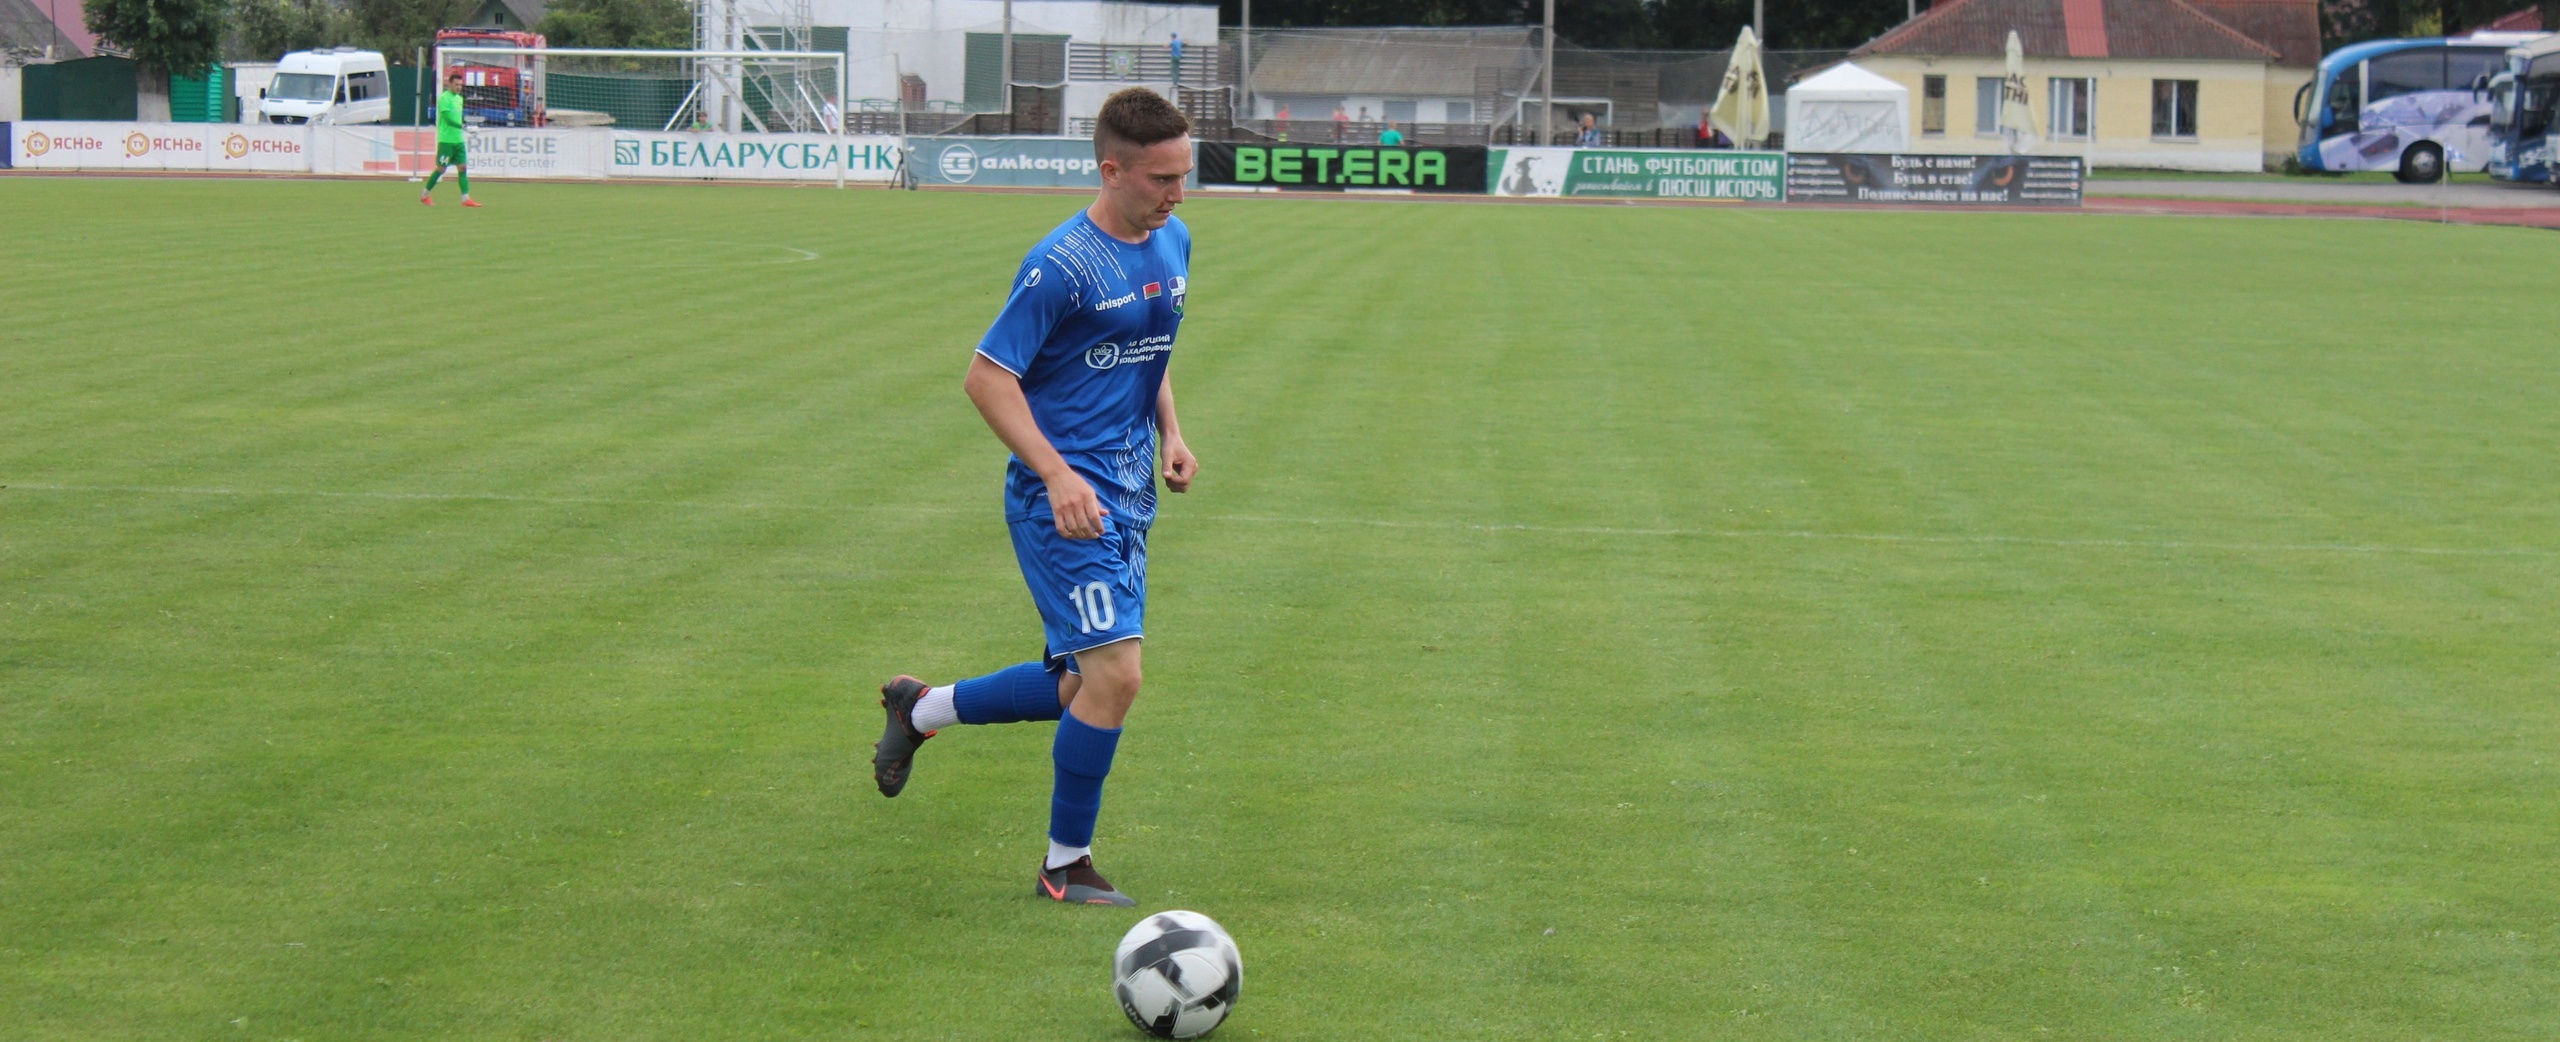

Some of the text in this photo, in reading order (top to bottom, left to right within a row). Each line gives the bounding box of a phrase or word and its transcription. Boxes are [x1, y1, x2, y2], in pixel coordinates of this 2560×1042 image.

[33, 140, 44, 148] TV
[133, 140, 144, 148] TV
[232, 141, 243, 149] TV
[468, 136, 557, 154] RILESIE
[468, 156, 556, 169] gistic Center
[651, 140, 895, 170] БЕЛАРУСБАНК
[1891, 155, 1976, 171] Будь с нами!
[1235, 147, 1447, 186] BET.ERA
[1582, 156, 1639, 174] СТАНЬ
[1658, 178, 1711, 197] ДЮСШ
[1714, 179, 1777, 198] ИСПОЧЬ
[1893, 172, 1973, 187] Будь в стае!
[1857, 187, 1958, 202] Подписывайся
[1961, 192, 1977, 201] на
[1980, 189, 2008, 202] нас!
[1095, 291, 1137, 312] uhlsport
[1068, 580, 1115, 634] 10
